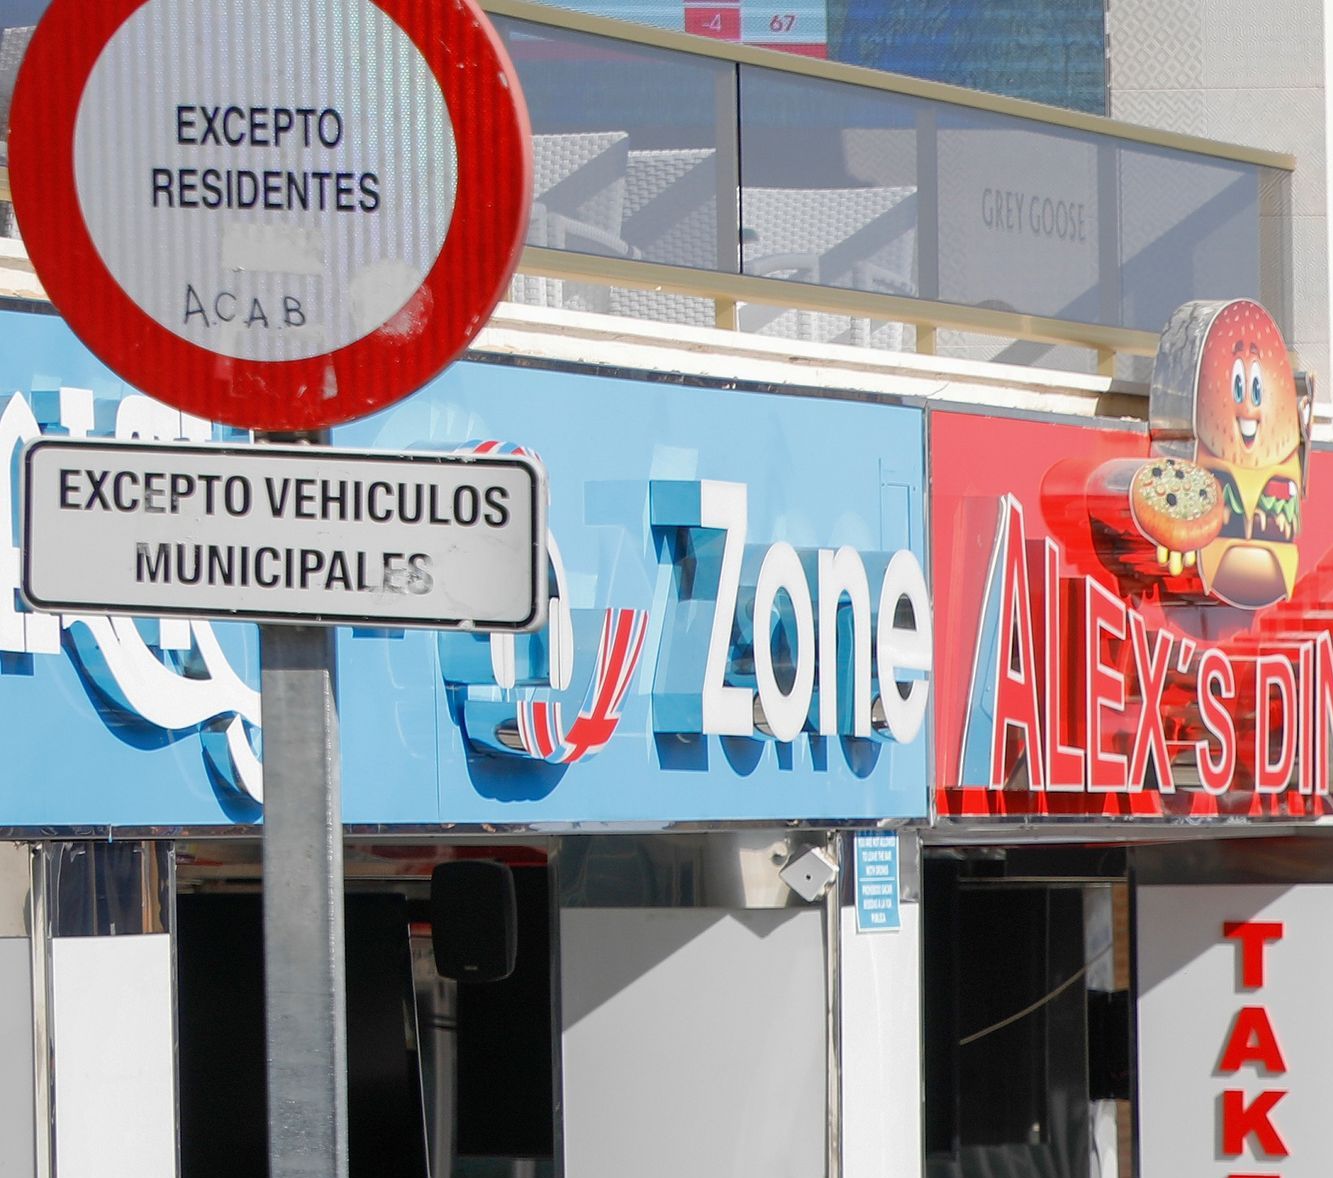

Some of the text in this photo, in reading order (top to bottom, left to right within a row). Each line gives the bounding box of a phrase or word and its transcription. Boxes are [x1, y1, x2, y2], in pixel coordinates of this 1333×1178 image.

[770, 15, 796, 33] 67
[176, 106, 342, 149] EXCEPTO
[152, 168, 381, 213] RESIDENTES
[982, 187, 1086, 243] GREY GOOSE
[58, 468, 511, 528] EXCEPTO VEHICULOS
[135, 541, 435, 597] MUNICIPALES
[700, 480, 932, 744] Zone
[988, 492, 1236, 796] ALEX'S
